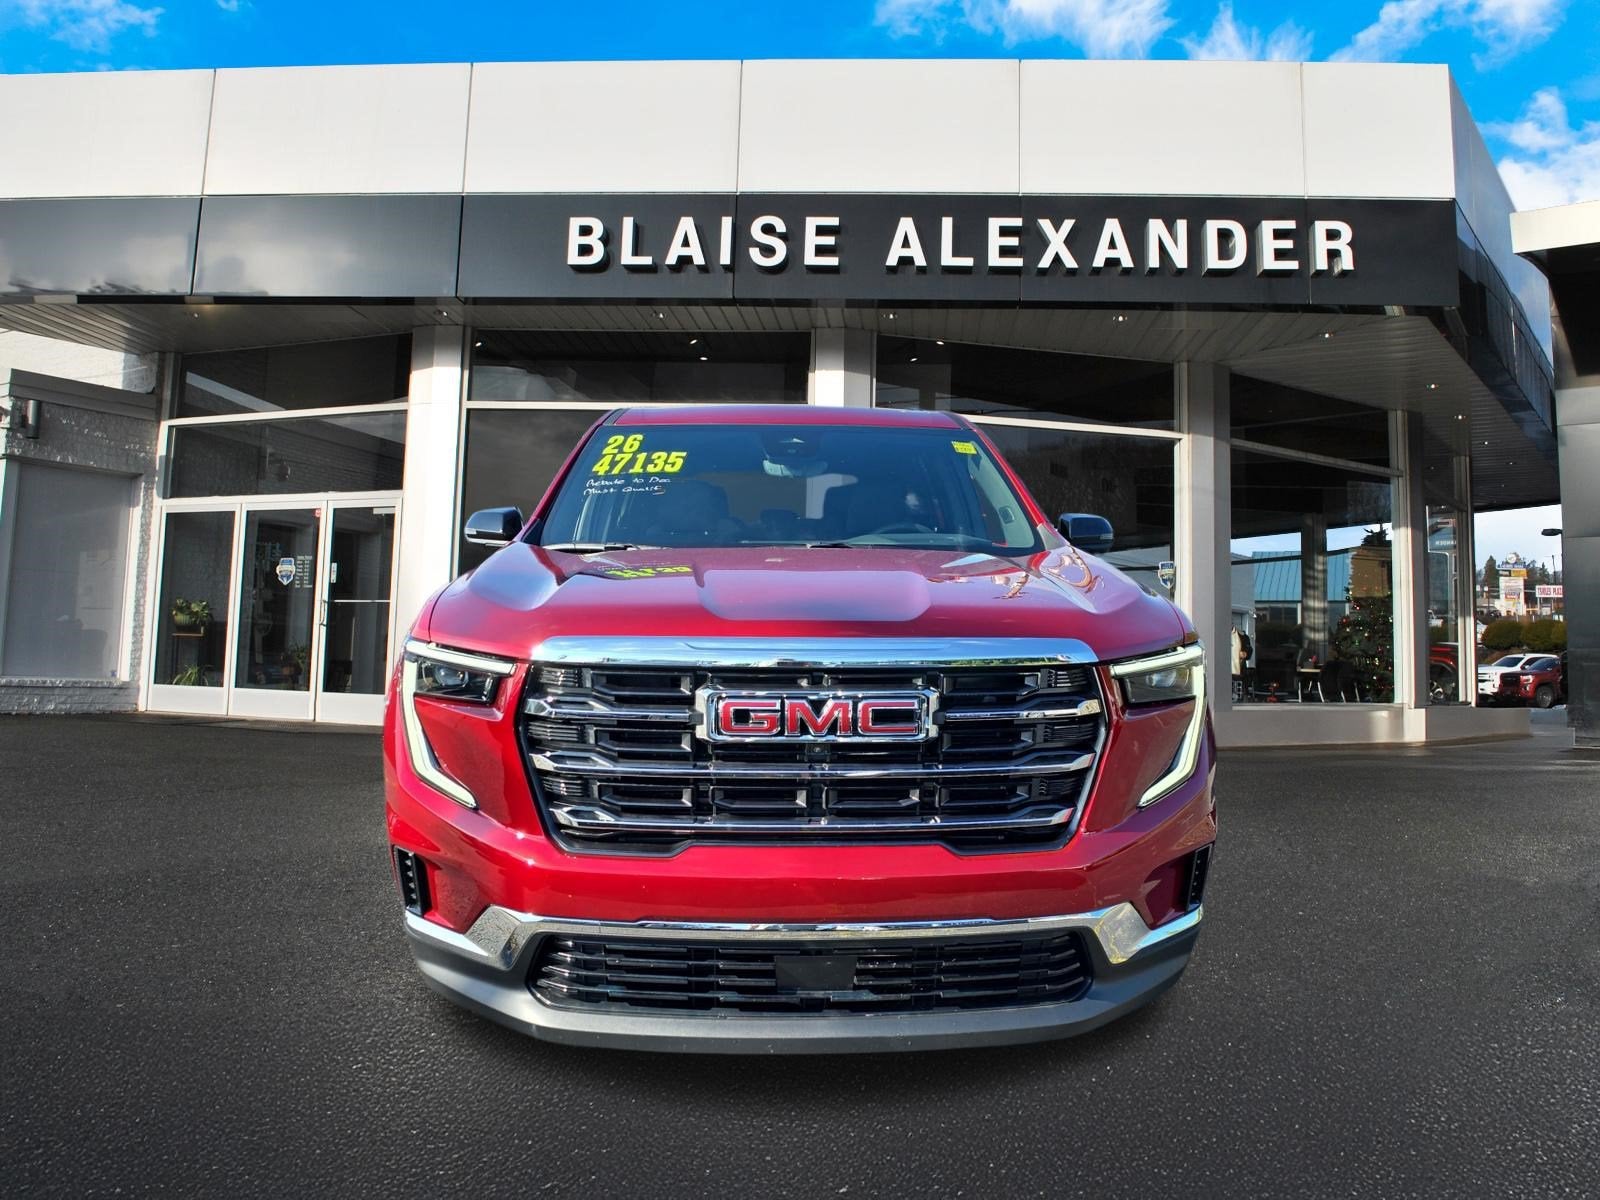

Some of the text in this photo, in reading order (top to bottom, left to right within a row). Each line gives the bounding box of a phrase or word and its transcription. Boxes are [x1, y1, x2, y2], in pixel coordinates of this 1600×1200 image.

[566, 215, 1355, 272] BLAISE ALEXANDER
[602, 434, 644, 454] 26
[592, 451, 688, 475] 47135
[719, 699, 919, 736] GMC
